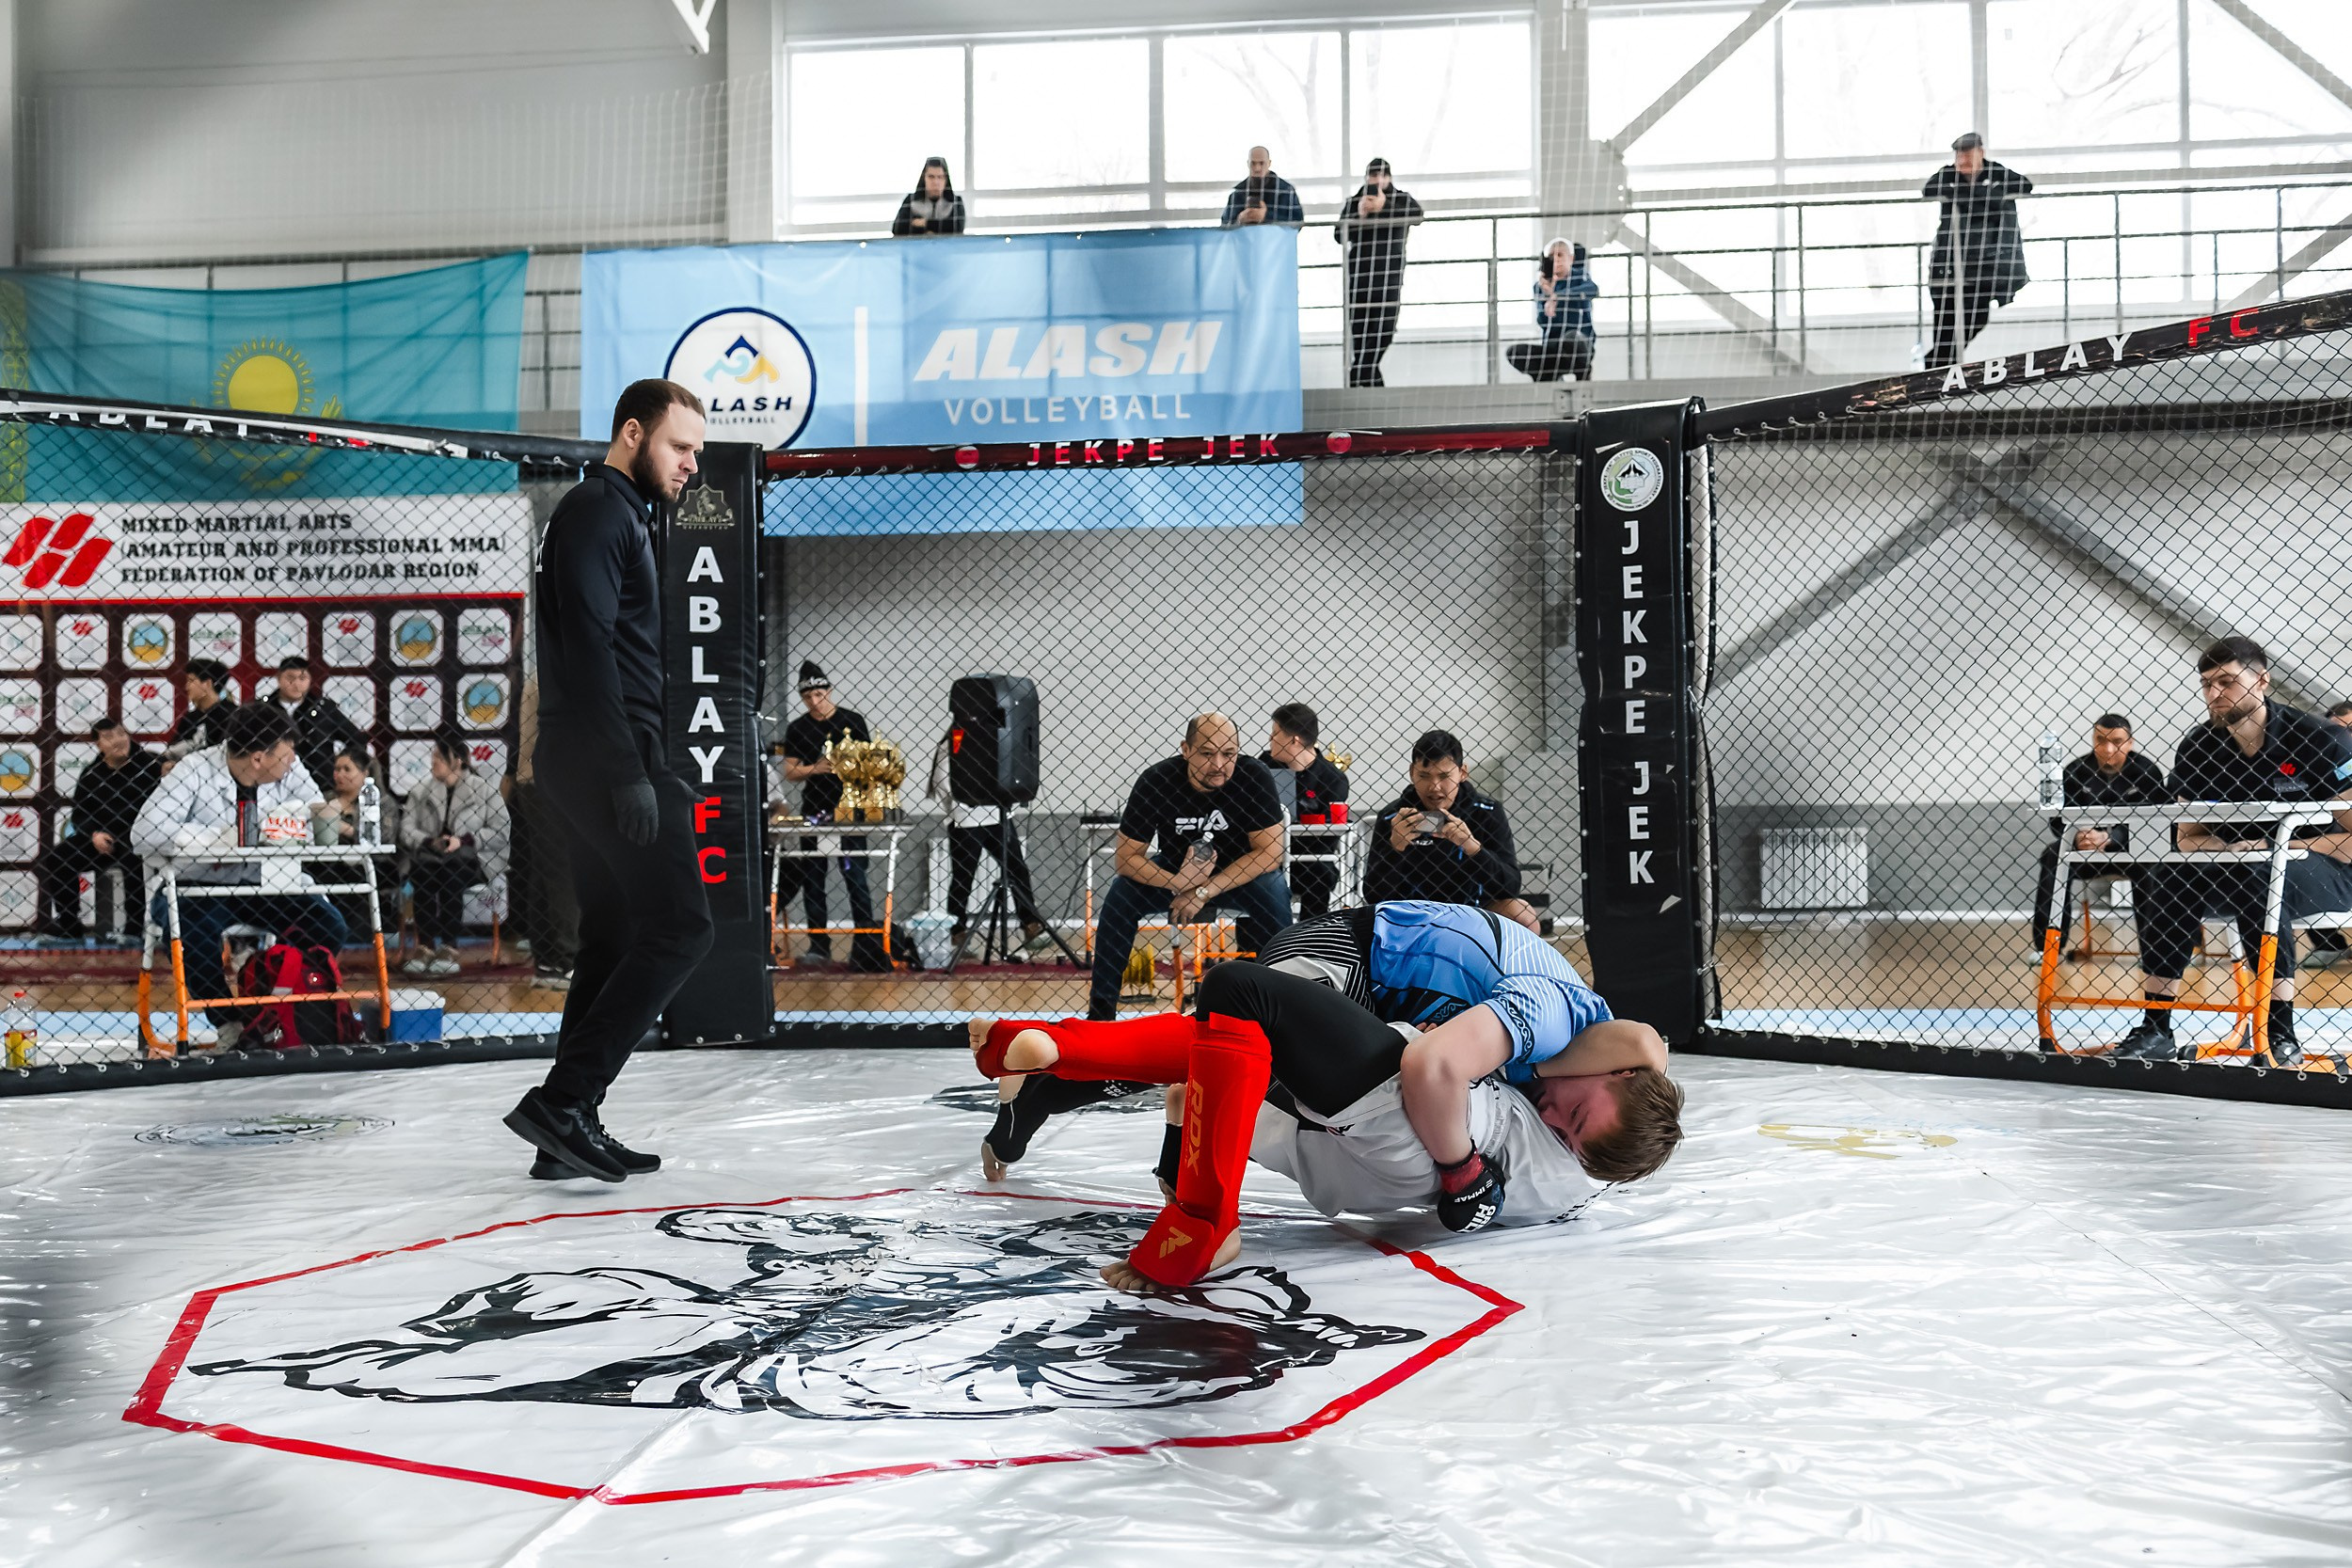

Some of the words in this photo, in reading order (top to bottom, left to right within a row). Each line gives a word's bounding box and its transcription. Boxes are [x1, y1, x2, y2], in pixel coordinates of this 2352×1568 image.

[914, 321, 1222, 382] ALASH
[1941, 331, 2137, 393] ABLAY
[2187, 308, 2260, 347] FC
[699, 396, 792, 412] LASH
[944, 392, 1192, 425] VOLLEYBALL
[1026, 437, 1165, 467] JEKPE
[1200, 433, 1279, 460] JEK
[121, 517, 186, 533] MIXED
[196, 515, 291, 534] MARTIAL
[298, 514, 352, 531] ARTS
[120, 542, 226, 560] (AMATEUR
[235, 541, 278, 558] AND
[287, 538, 442, 557] PROFESSIONAL
[452, 537, 506, 554] MMA)
[121, 566, 246, 583] FEDERATION
[255, 566, 280, 582] OF
[287, 563, 395, 581] PAVLODAR
[404, 562, 480, 579] REGION
[1621, 519, 1647, 735] JEKPE
[687, 546, 725, 784] ABLAY
[694, 796, 727, 884] FC
[1629, 760, 1655, 884] JEK
[1187, 1078, 1204, 1177] RDX
[1454, 1186, 1486, 1203] IMMAF
